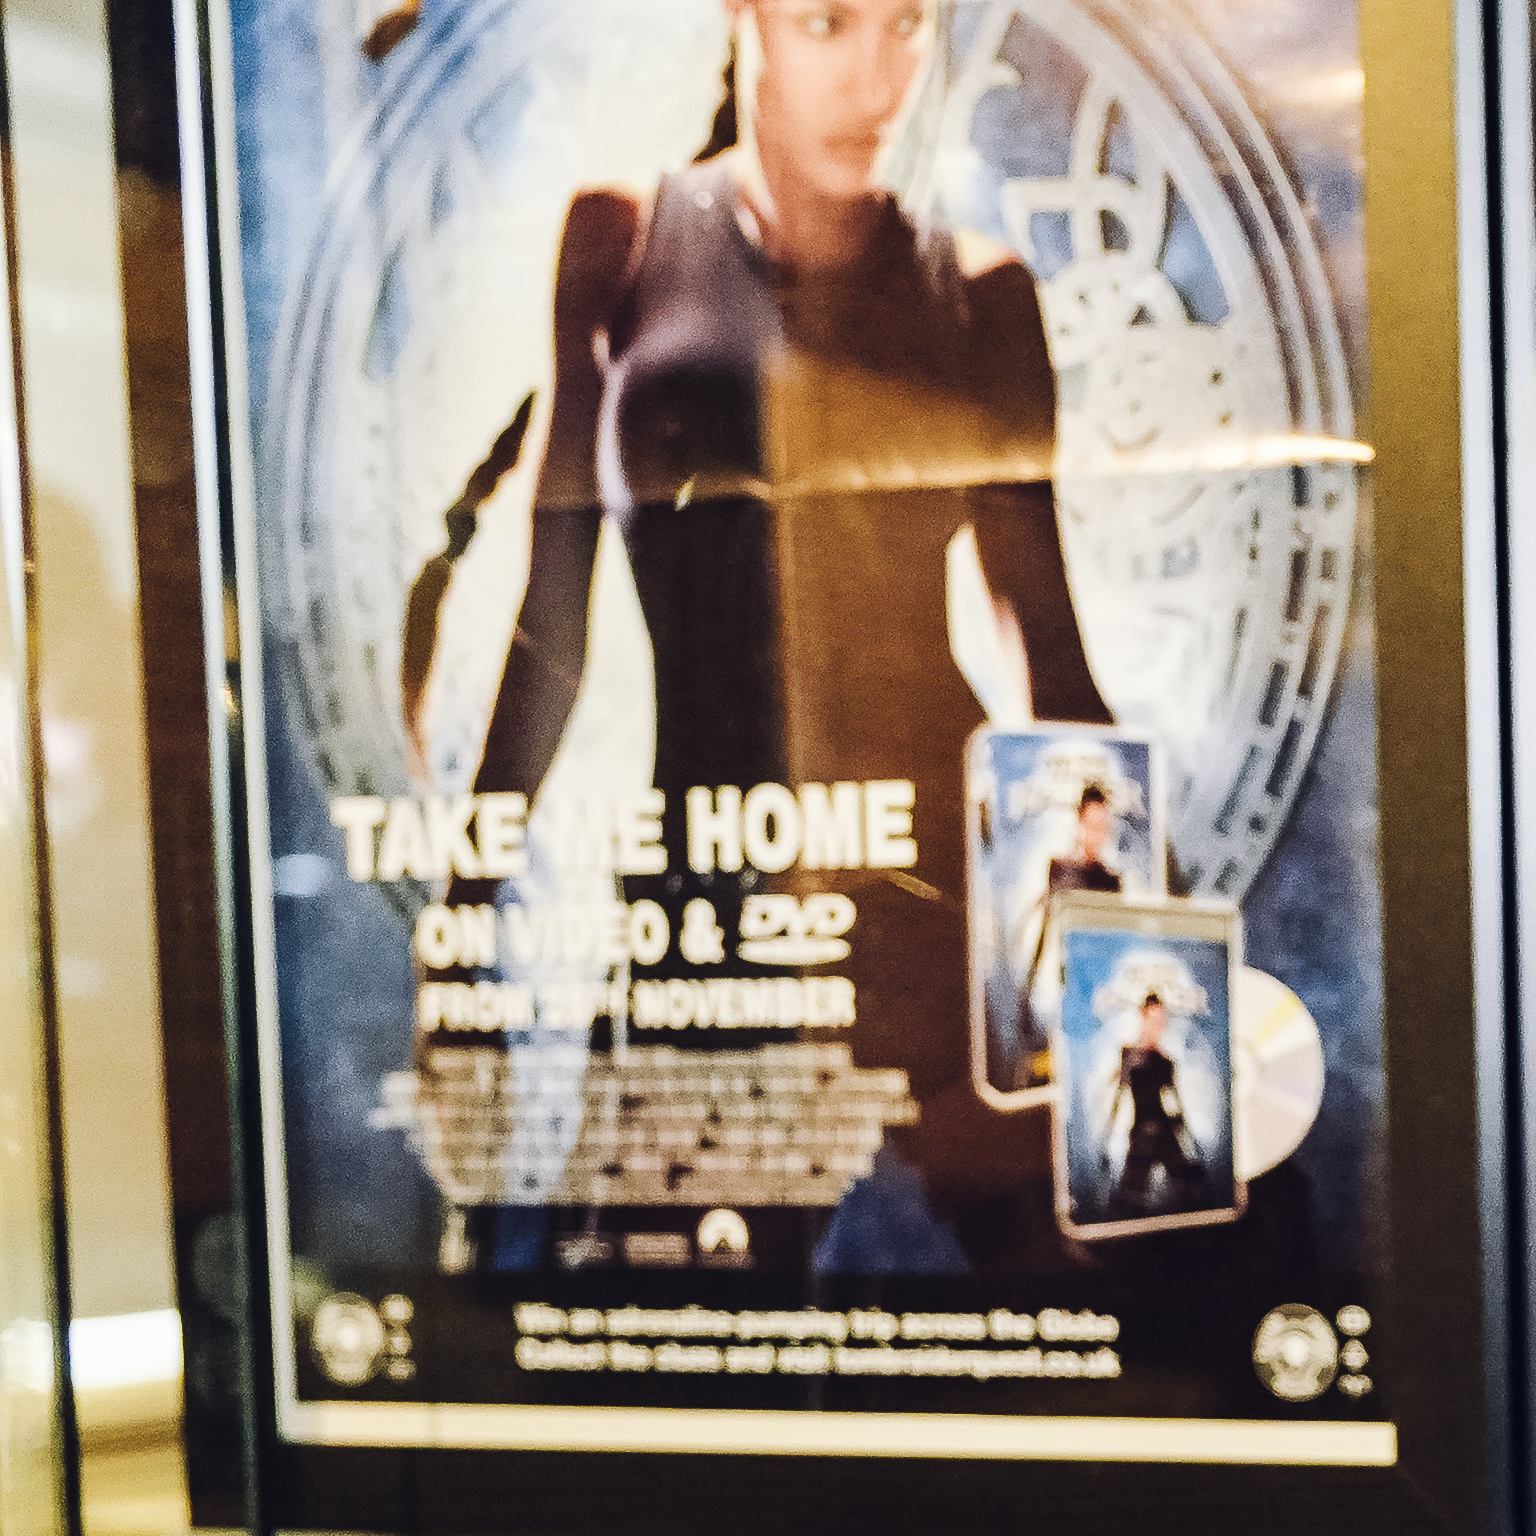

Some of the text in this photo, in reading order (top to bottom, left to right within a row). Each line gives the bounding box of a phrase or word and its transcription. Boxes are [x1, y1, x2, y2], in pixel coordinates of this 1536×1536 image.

[330, 791, 529, 882] TAKE
[685, 779, 918, 874] HOME
[414, 902, 498, 969] ON
[501, 897, 670, 967] VIDEO
[679, 897, 726, 965] &
[418, 981, 535, 1031] FROM
[631, 976, 857, 1030] NOVEMBER
